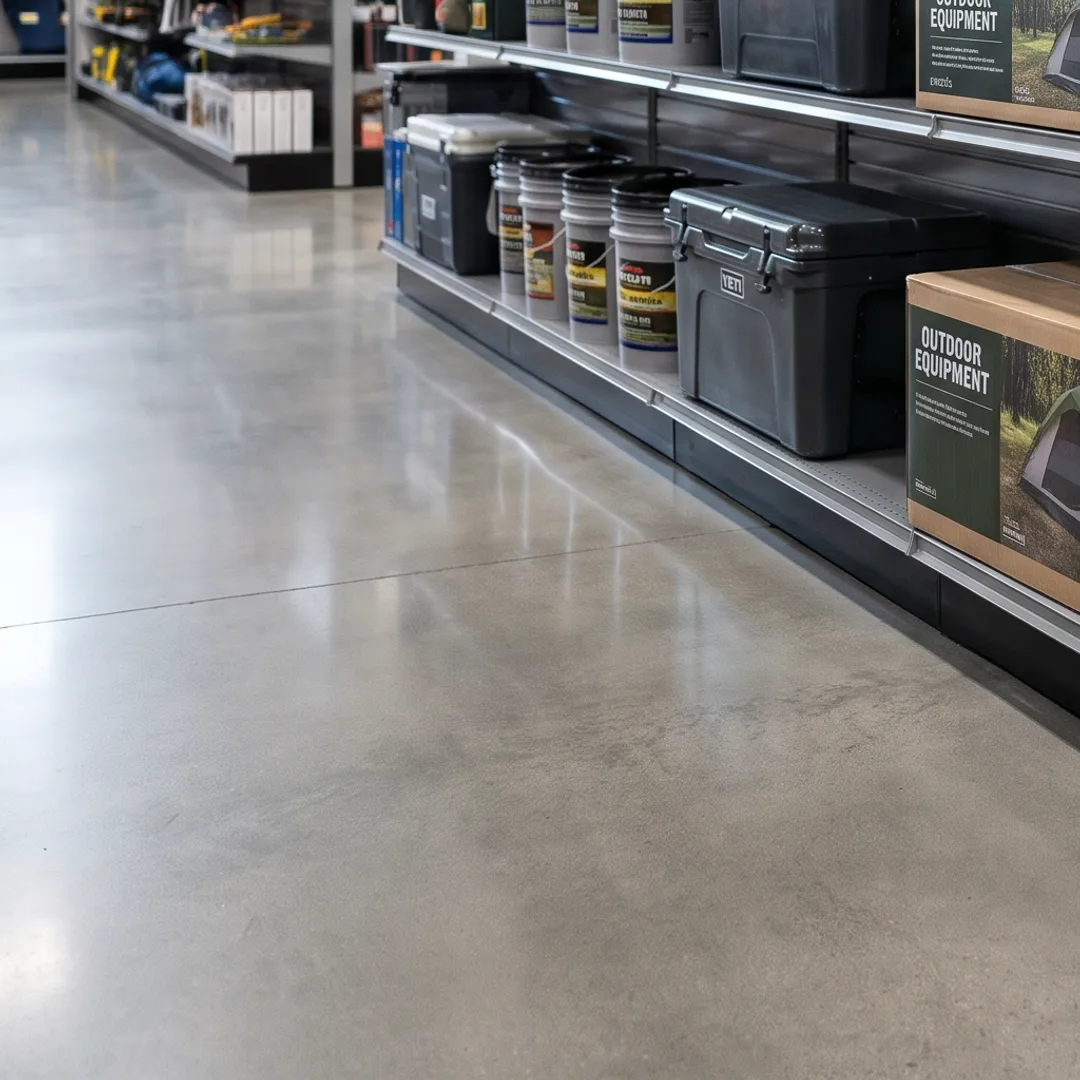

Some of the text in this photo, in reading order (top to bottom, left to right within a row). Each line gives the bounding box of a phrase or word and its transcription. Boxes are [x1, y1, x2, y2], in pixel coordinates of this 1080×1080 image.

[930, 8, 998, 32] EQUIPMENT
[722, 273, 742, 294] YETI
[921, 325, 982, 367] OUTDOOR
[915, 348, 990, 395] EQUIPMENT
